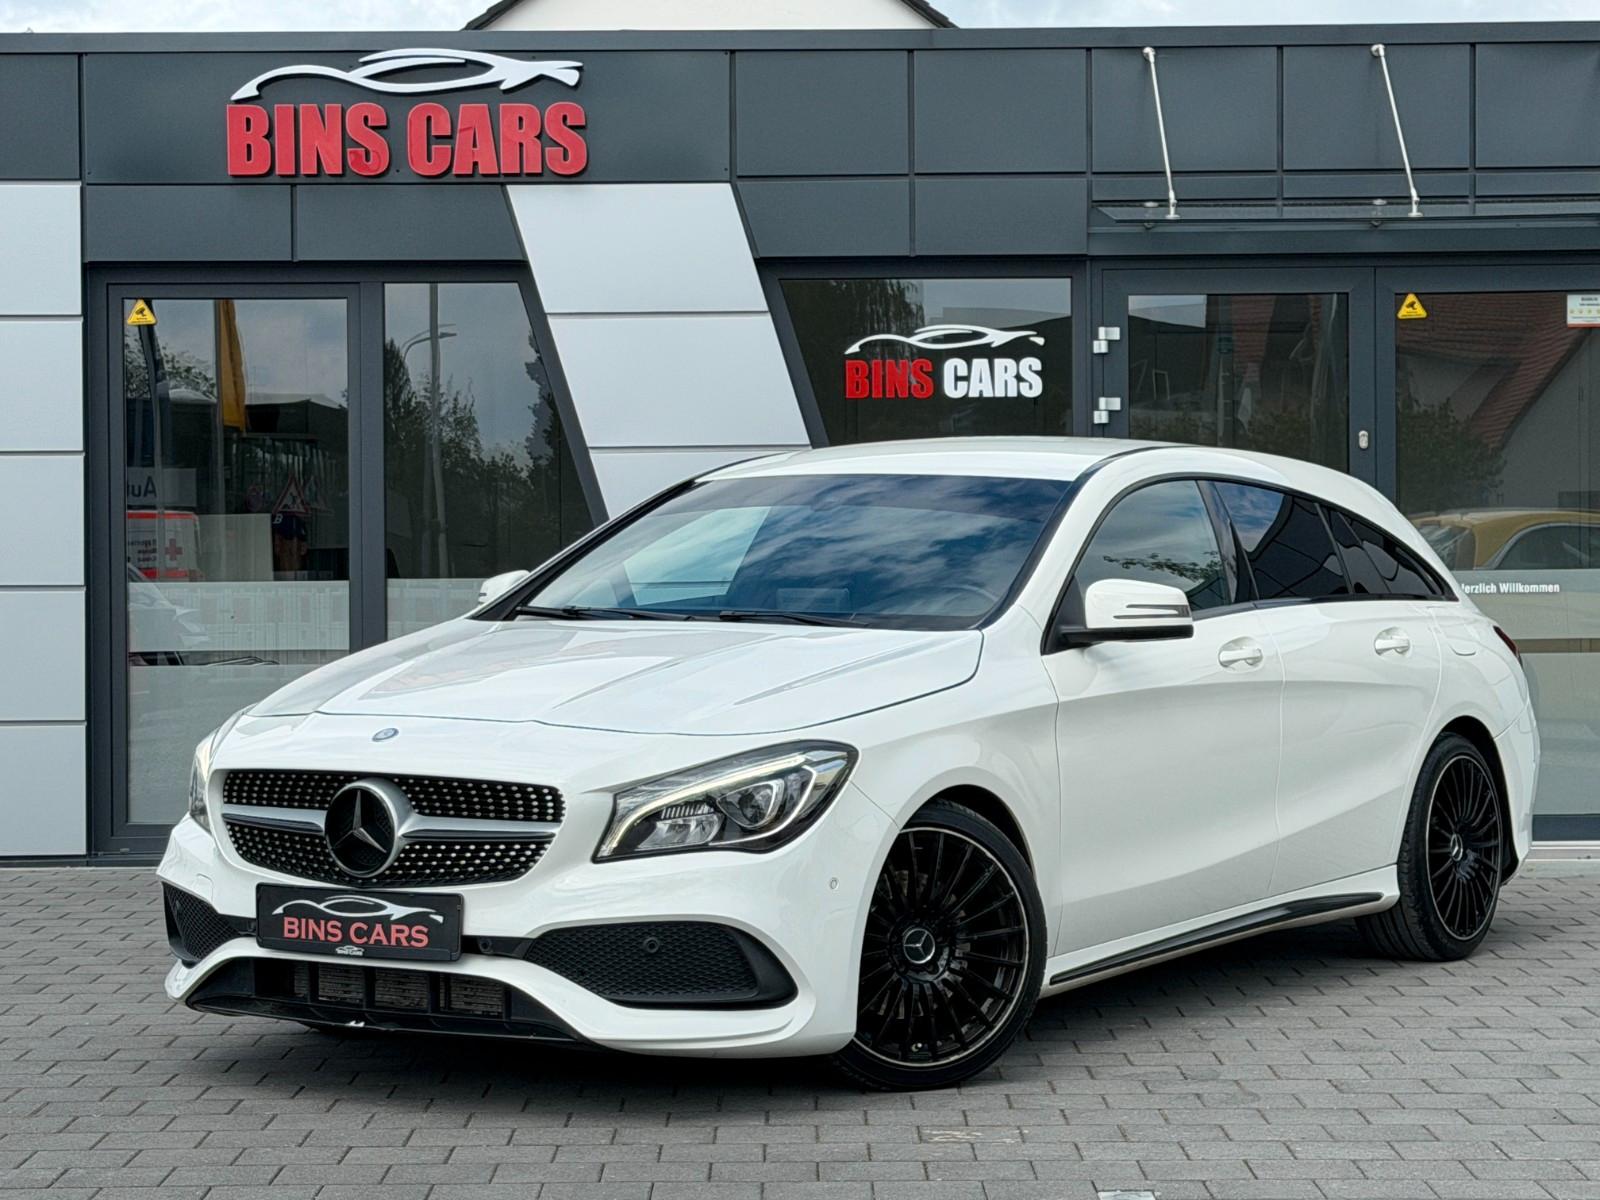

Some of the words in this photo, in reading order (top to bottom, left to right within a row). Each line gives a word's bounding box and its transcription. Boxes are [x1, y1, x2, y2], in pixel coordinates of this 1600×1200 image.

[226, 102, 391, 177] BINS
[407, 102, 588, 176] CARS
[845, 358, 934, 399] BINS
[943, 357, 1043, 399] CARS
[1499, 582, 1560, 594] Willkommen
[283, 916, 343, 942] BINS
[350, 921, 429, 948] CARS
